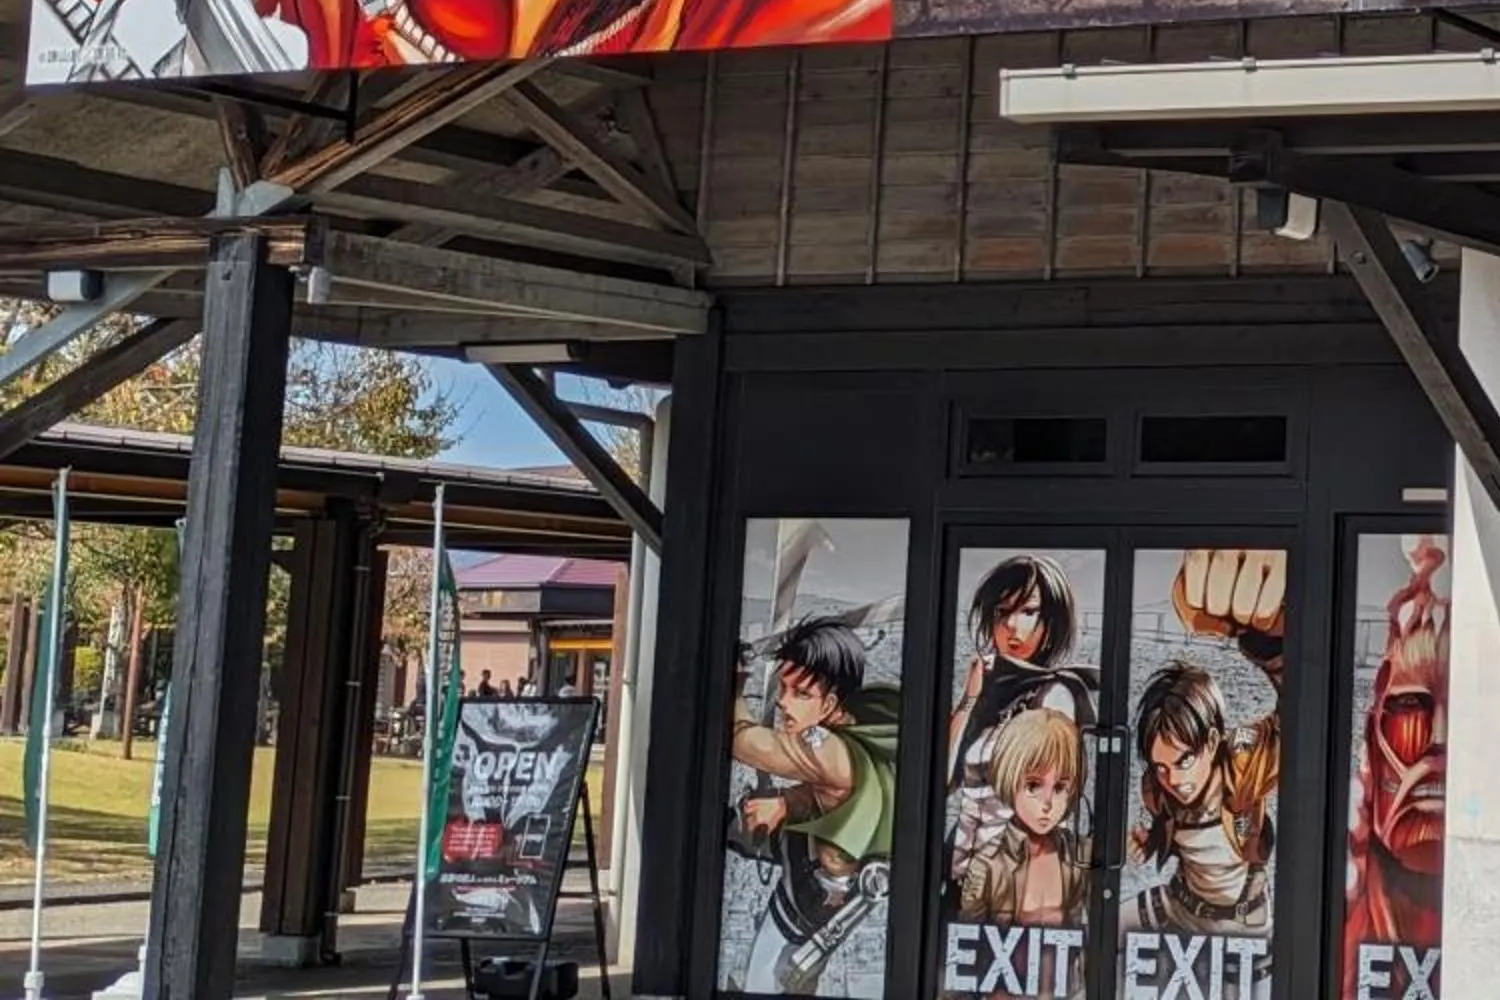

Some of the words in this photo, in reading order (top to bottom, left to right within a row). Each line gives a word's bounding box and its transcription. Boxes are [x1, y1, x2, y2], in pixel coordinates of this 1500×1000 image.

[944, 922, 1084, 998] EXIT
[1124, 932, 1268, 1000] EXIT
[1356, 943, 1441, 1000] EX
